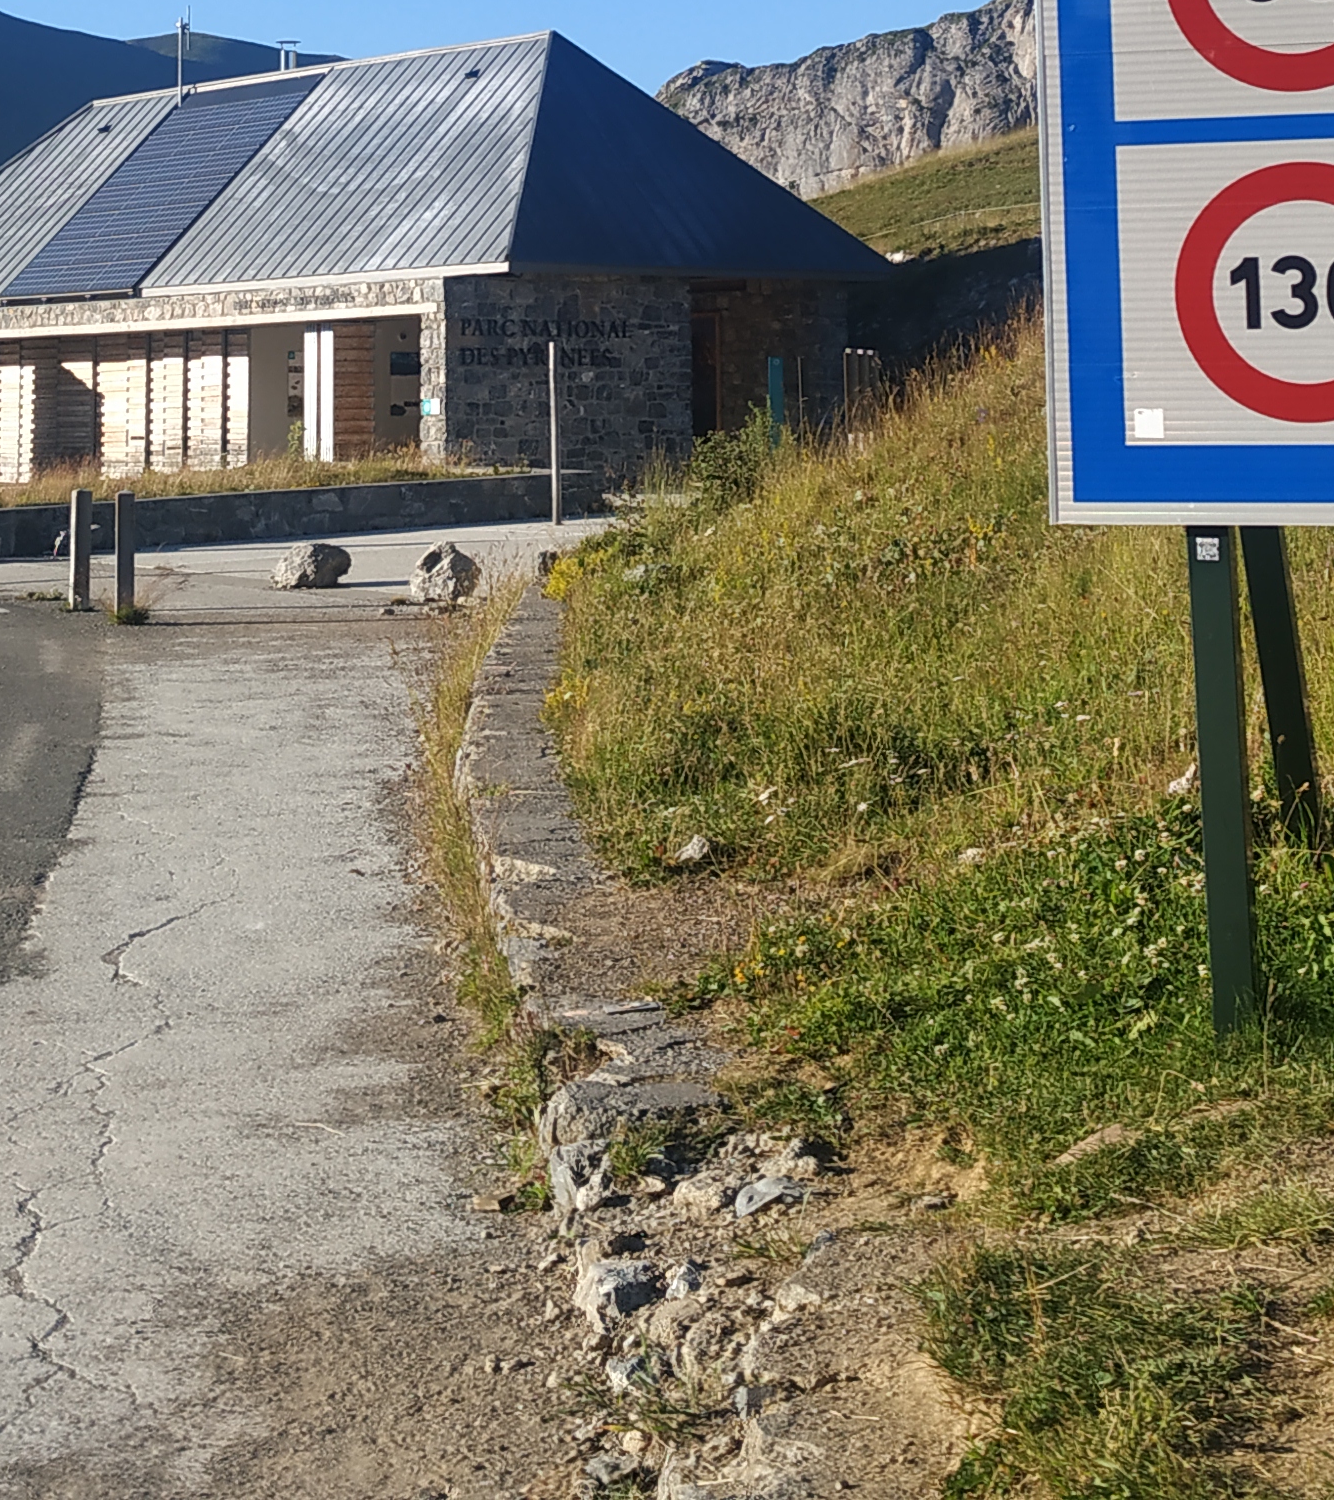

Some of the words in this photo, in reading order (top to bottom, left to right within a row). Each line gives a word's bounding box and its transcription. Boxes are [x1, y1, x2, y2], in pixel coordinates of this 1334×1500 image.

[460, 318, 517, 337] PARC
[520, 319, 633, 339] NATIONAL
[460, 347, 499, 367] DES
